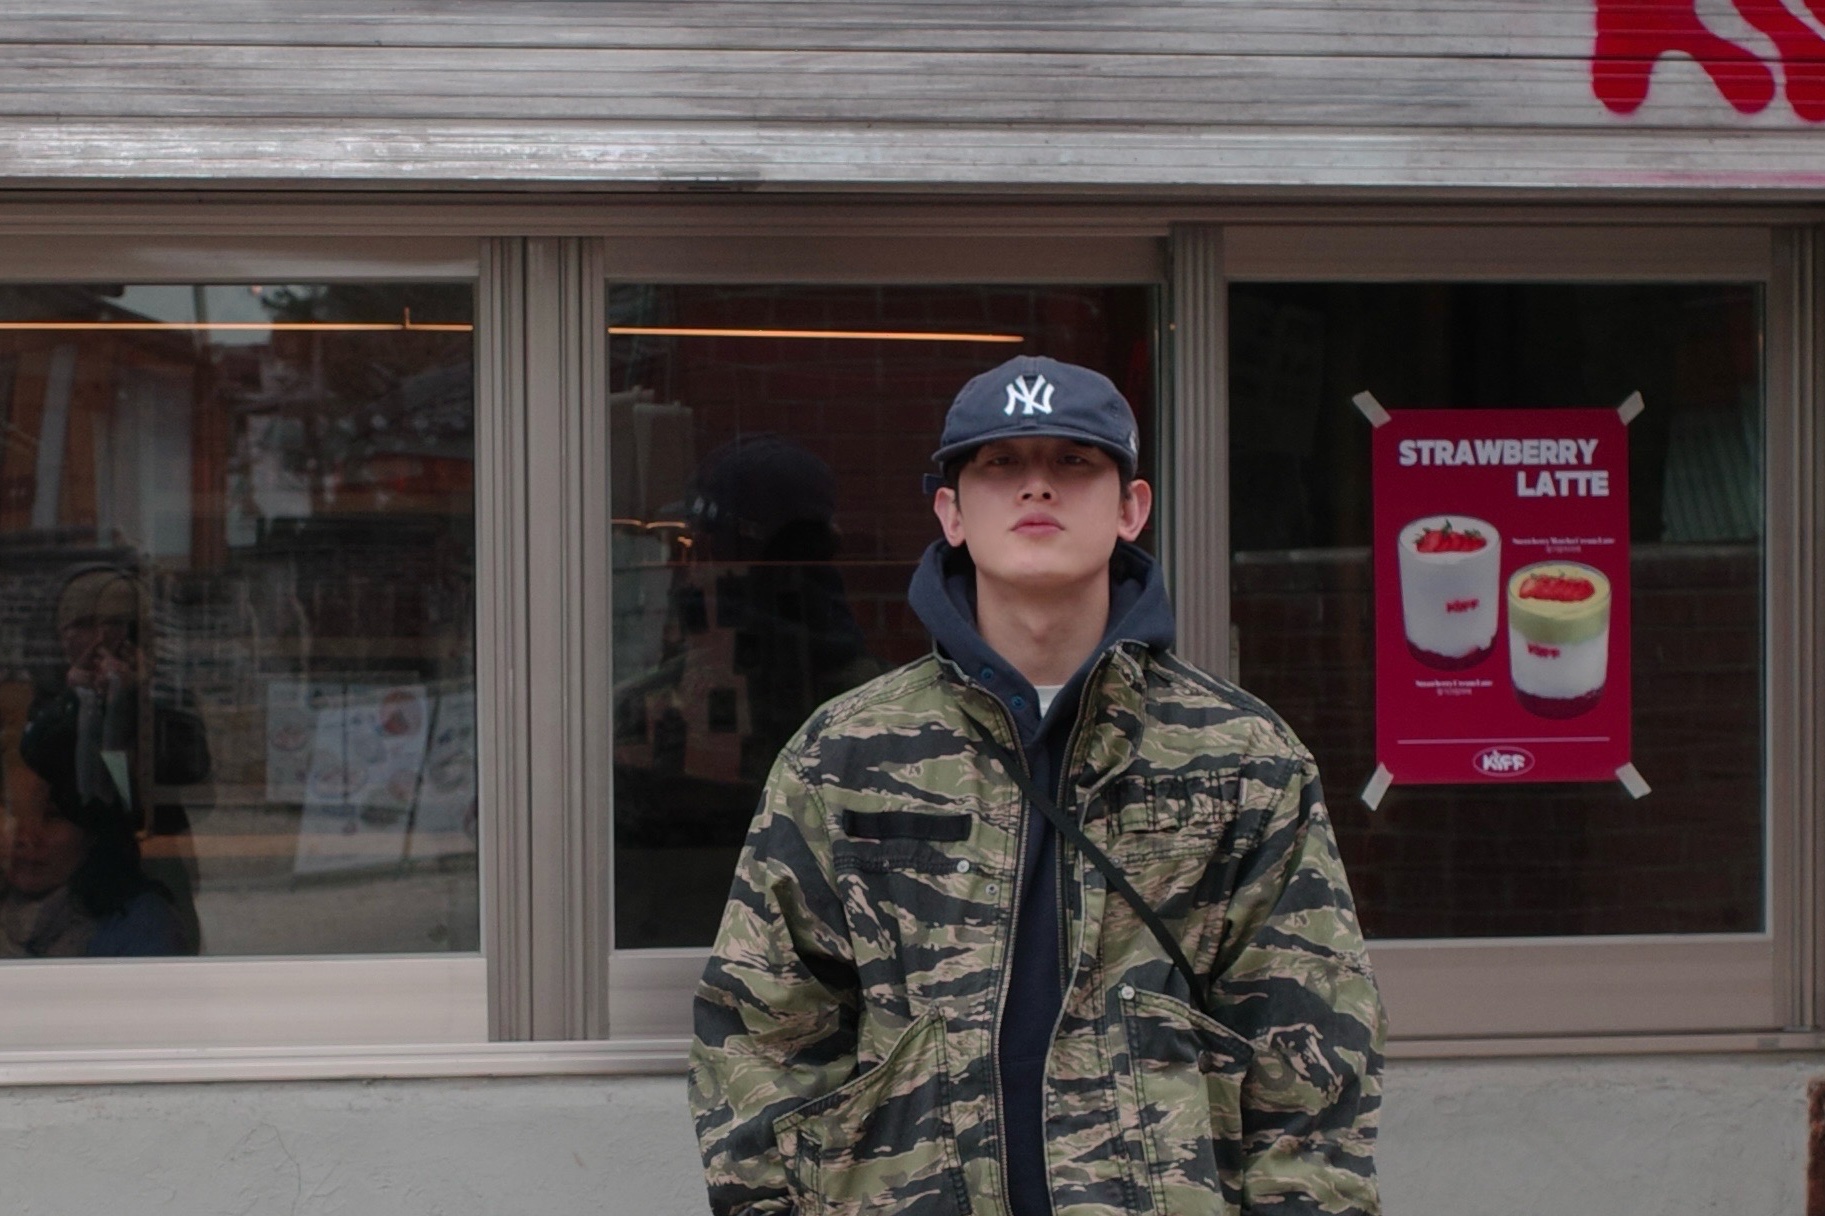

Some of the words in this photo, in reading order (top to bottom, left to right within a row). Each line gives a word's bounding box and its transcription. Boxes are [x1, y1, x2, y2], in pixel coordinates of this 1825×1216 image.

[1004, 374, 1055, 416] NY
[1398, 438, 1599, 466] STRAWBERRY
[1516, 470, 1610, 497] LATTE
